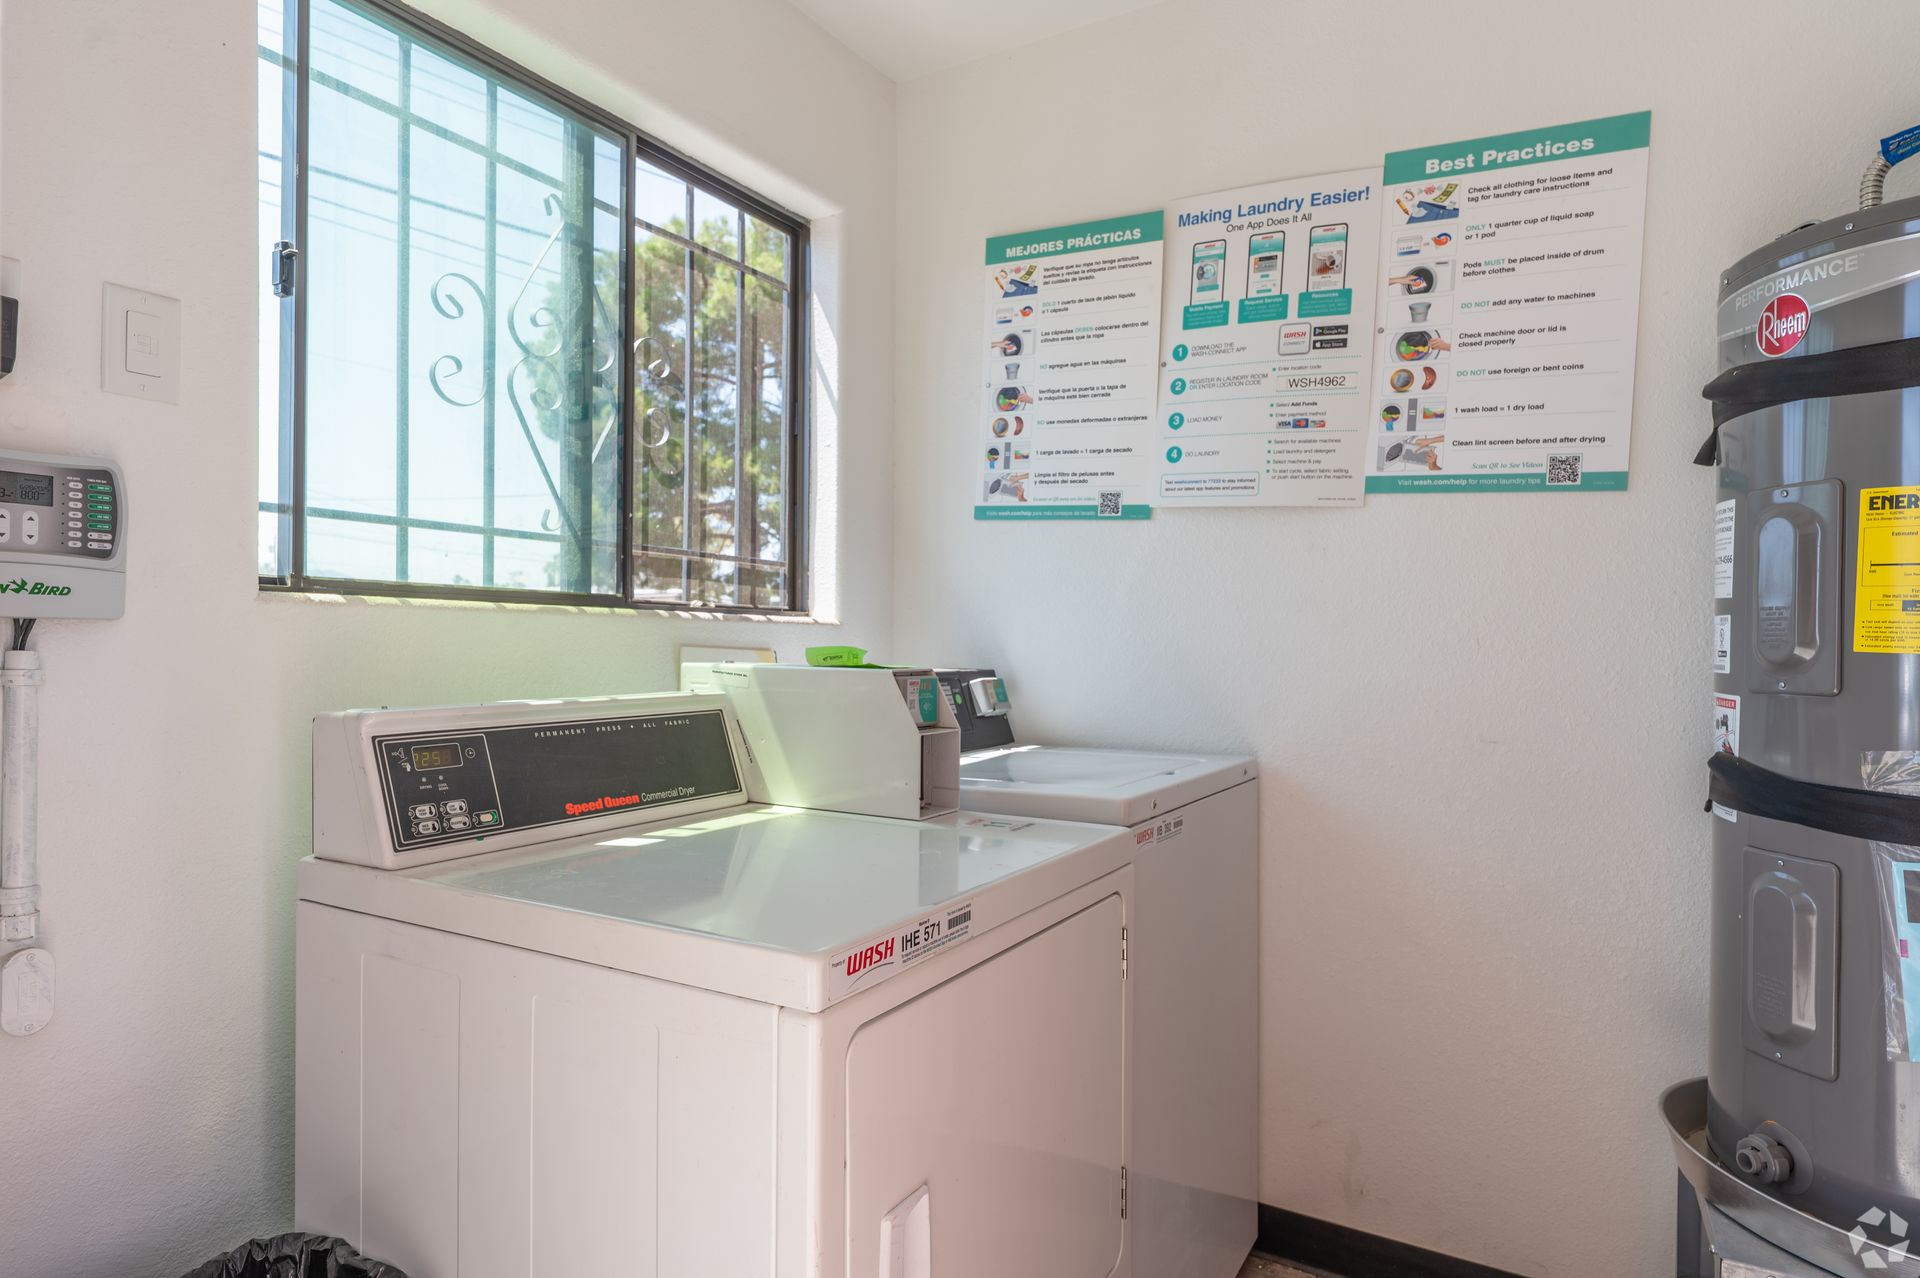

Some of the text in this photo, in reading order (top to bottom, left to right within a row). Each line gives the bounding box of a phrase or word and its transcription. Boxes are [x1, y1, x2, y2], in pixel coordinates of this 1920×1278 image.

[1425, 137, 1594, 174] Best Practices
[1468, 186, 1491, 194] Check
[1503, 180, 1535, 189] clothing
[1597, 168, 1613, 176] and
[1523, 185, 1541, 195] care
[1542, 181, 1590, 192] instructions
[1178, 187, 1370, 227] Making Laundry Easier!
[1225, 213, 1312, 233] One App Does It All
[1465, 224, 1486, 232] ONLY
[1494, 220, 1522, 229] quarter
[1550, 213, 1573, 221] liquid
[1006, 229, 1141, 257] MEJORES PRÁCTICAS
[1481, 231, 1496, 239] pod
[1483, 258, 1506, 266] MUST
[1519, 254, 1545, 264] placed
[1735, 255, 1859, 312] PERFORMANCE
[1762, 298, 1806, 348] Rheem
[1484, 338, 1516, 347] properly
[1288, 376, 1346, 388] WSH4962
[28, 582, 71, 595] BIRD
[534, 728, 586, 738] PERMANENT
[565, 786, 696, 816] Speed Queen Commercial Dryer
[847, 937, 895, 976] WASH
[902, 930, 920, 952] IHE
[924, 920, 940, 942] 571
